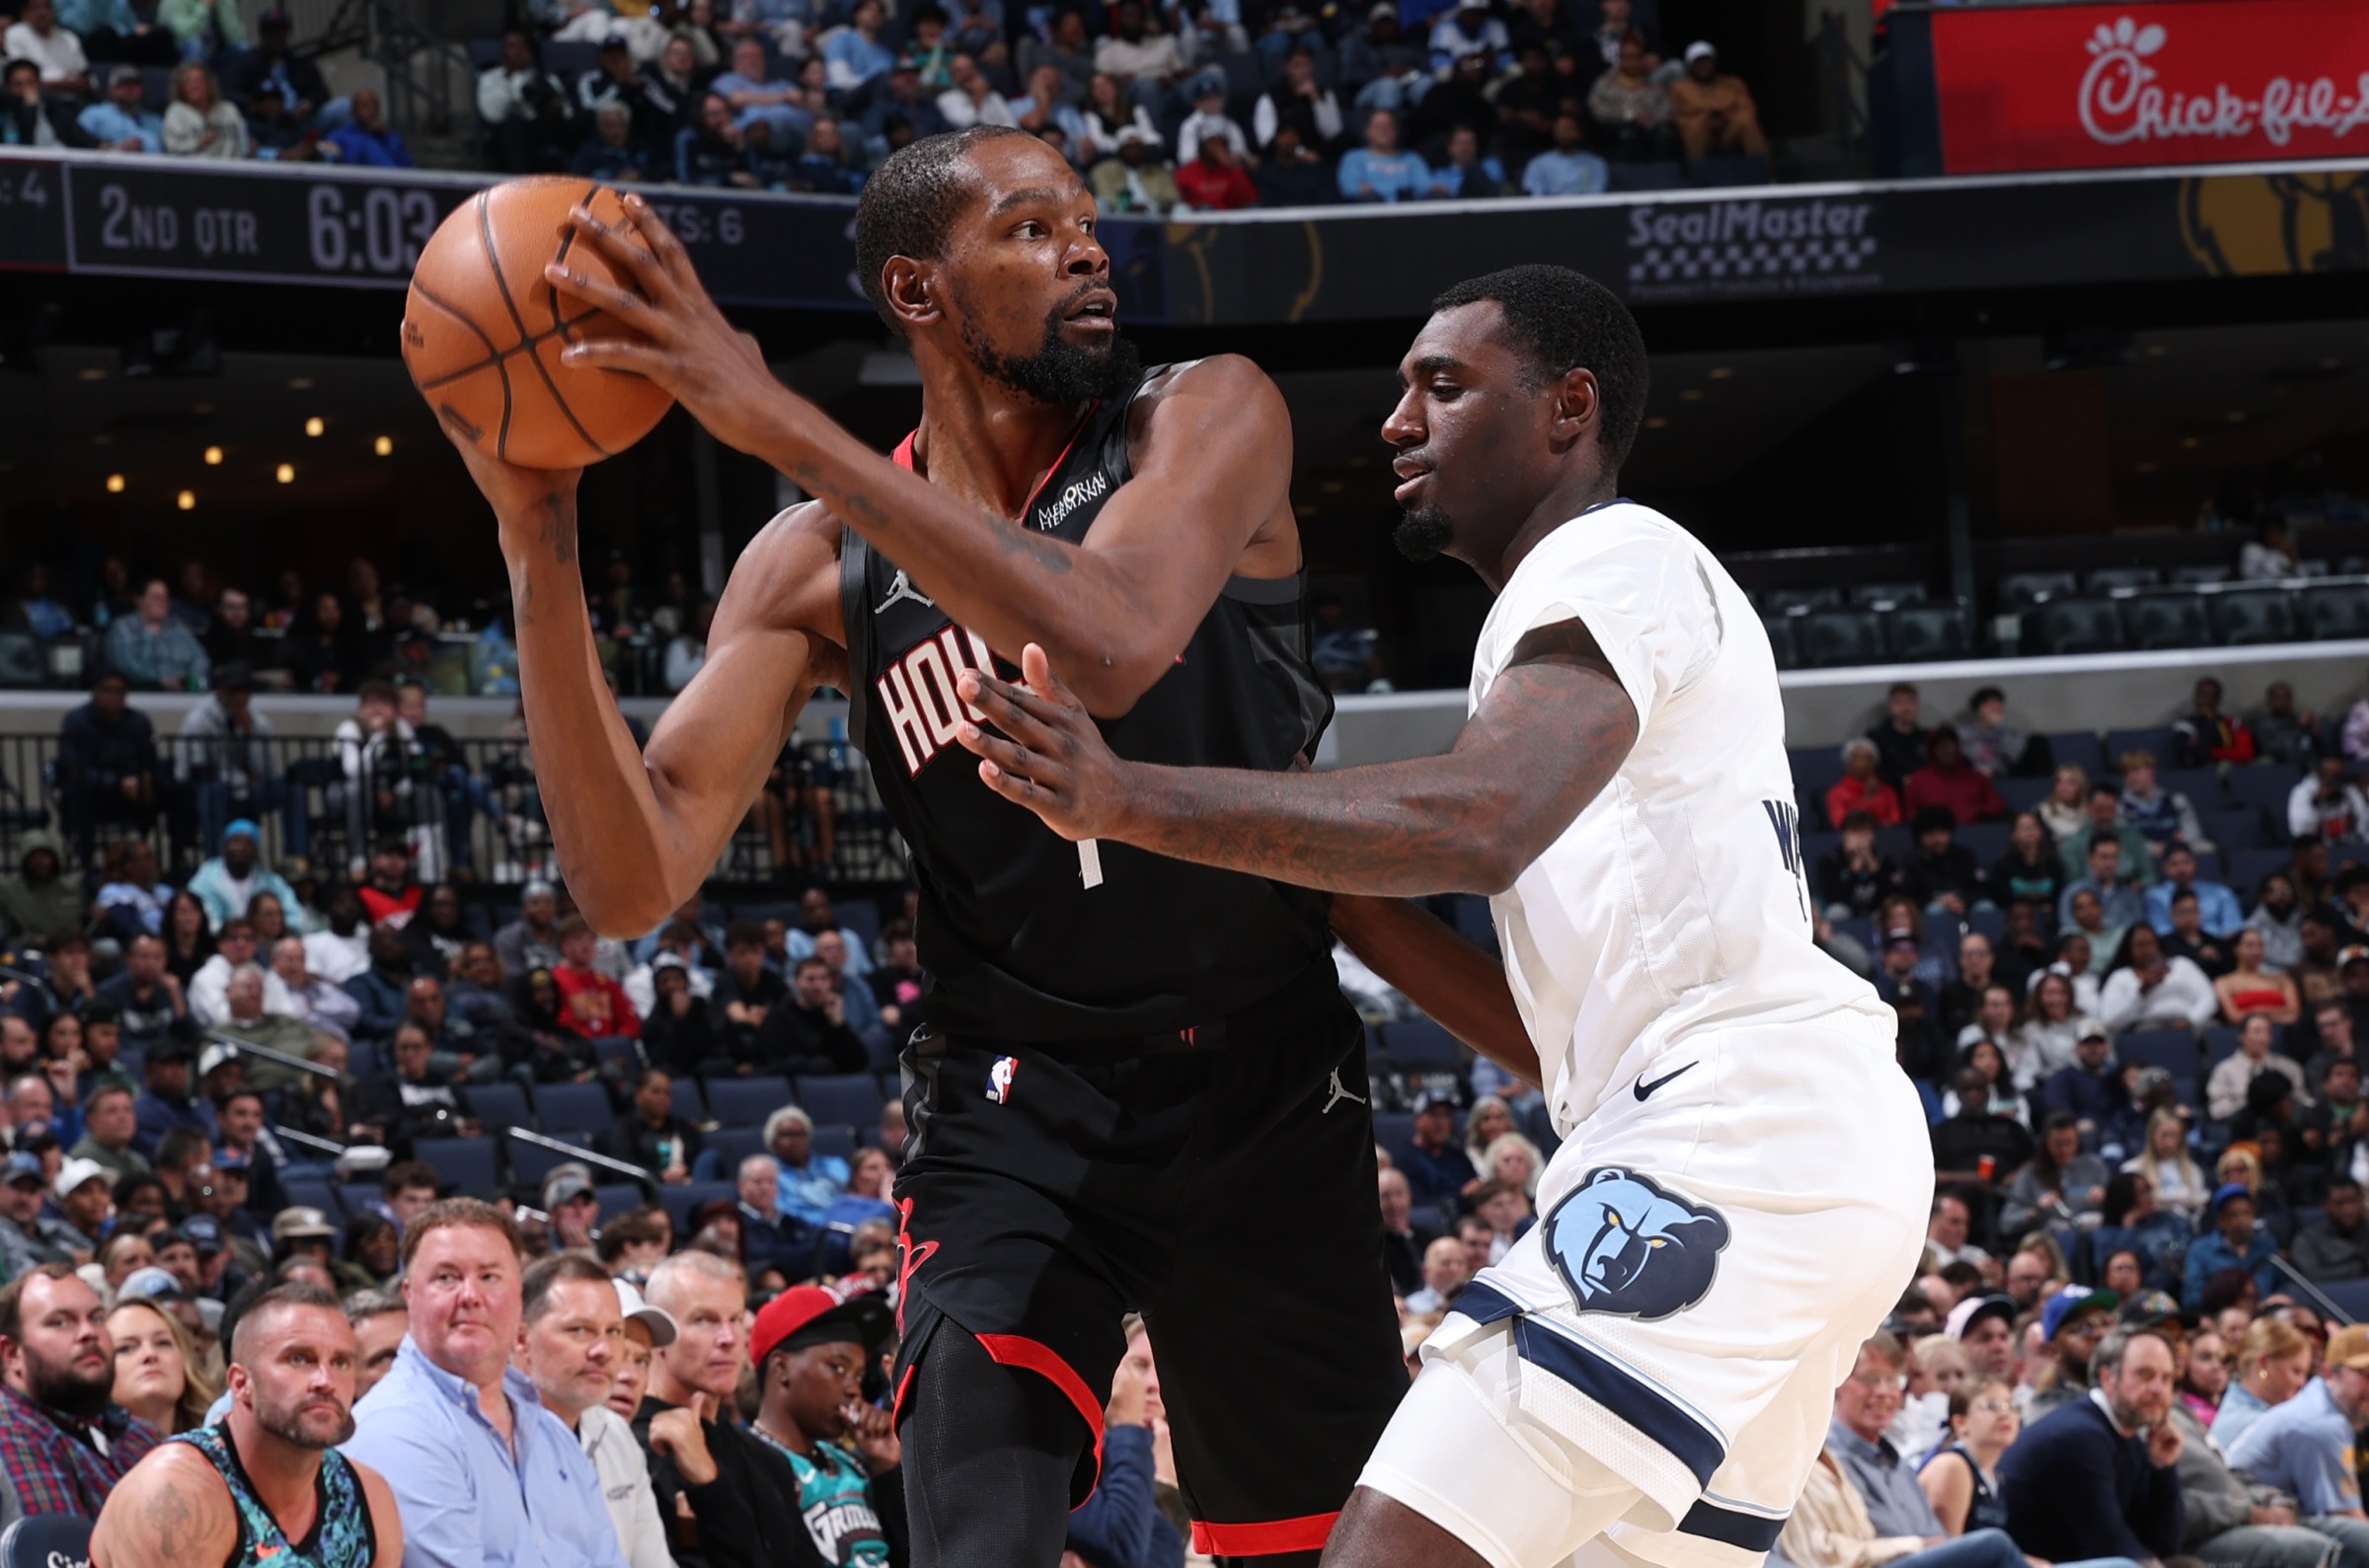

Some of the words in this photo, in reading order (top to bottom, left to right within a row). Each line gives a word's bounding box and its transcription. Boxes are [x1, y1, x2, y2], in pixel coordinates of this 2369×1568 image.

[101, 184, 179, 250] 2ND
[196, 209, 259, 255] QTR
[309, 185, 436, 271] 6:03
[718, 207, 744, 245] 6
[1628, 200, 1872, 246] SealMaster
[1038, 471, 1106, 520] MEMORIAL
[1039, 477, 1106, 531] HERMANN
